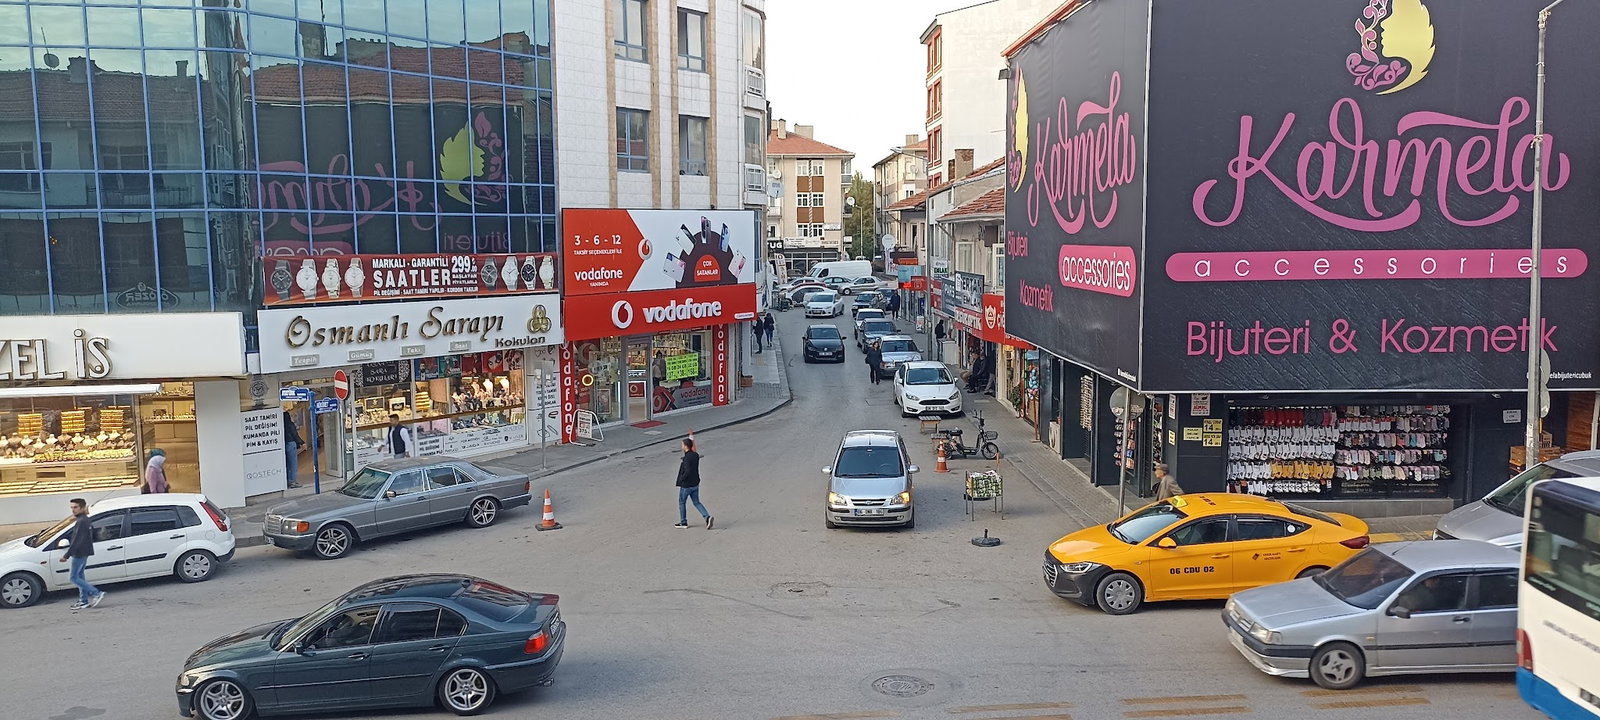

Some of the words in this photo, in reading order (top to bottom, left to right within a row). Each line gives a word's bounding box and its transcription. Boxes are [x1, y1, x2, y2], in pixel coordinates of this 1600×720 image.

[1028, 71, 1136, 235] Karmela
[1193, 96, 1571, 232] Karmela
[574, 235, 581, 246] 3
[593, 235, 600, 245] 6
[612, 234, 622, 245] 12
[1008, 231, 1028, 260] Bijuteri
[372, 258, 406, 269] MARKALI
[411, 256, 449, 268] GARANTİLİ
[574, 267, 623, 281] vodafone
[1062, 252, 1131, 291] accessories
[1194, 252, 1567, 277] accessories
[373, 269, 451, 289] SAATLER
[1020, 280, 1054, 313] Kozmetik
[643, 298, 722, 323] vodafone
[287, 314, 409, 349] Osmanlı
[419, 306, 504, 342] Sarayı
[1187, 321, 1311, 363] Bijuteri
[1330, 320, 1358, 354] &
[1381, 317, 1559, 353] Kozmetk
[243, 431, 269, 440] KUMANDA
[1169, 567, 1181, 575] 06
[1183, 566, 1200, 574] CDU
[1203, 565, 1215, 573] 02
